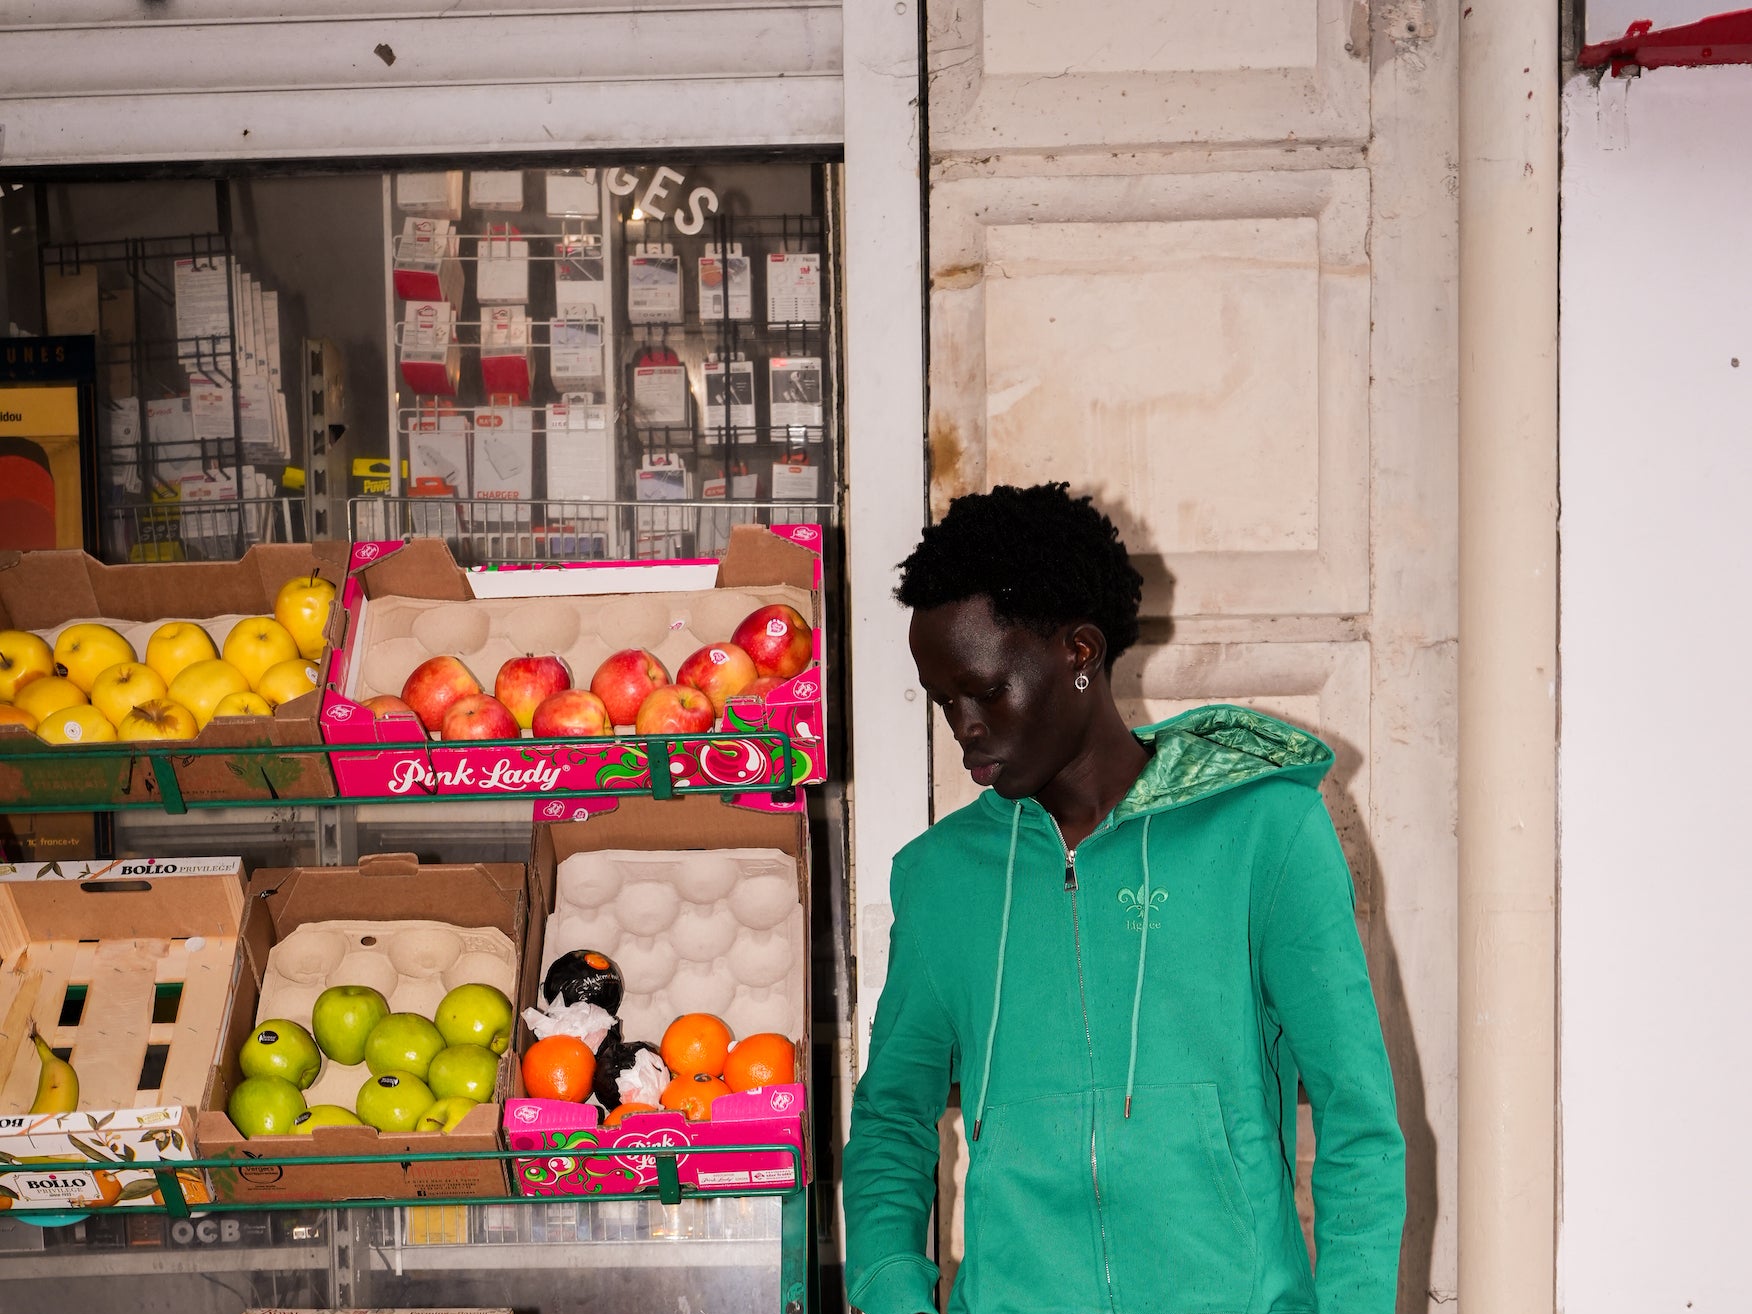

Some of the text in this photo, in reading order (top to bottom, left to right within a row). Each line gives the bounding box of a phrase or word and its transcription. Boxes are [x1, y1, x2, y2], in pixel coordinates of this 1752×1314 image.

[388, 758, 562, 793] Pink Lady
[121, 864, 177, 875] BOLLO
[26, 1178, 86, 1189] BOLLO
[171, 1219, 241, 1244] OCB
